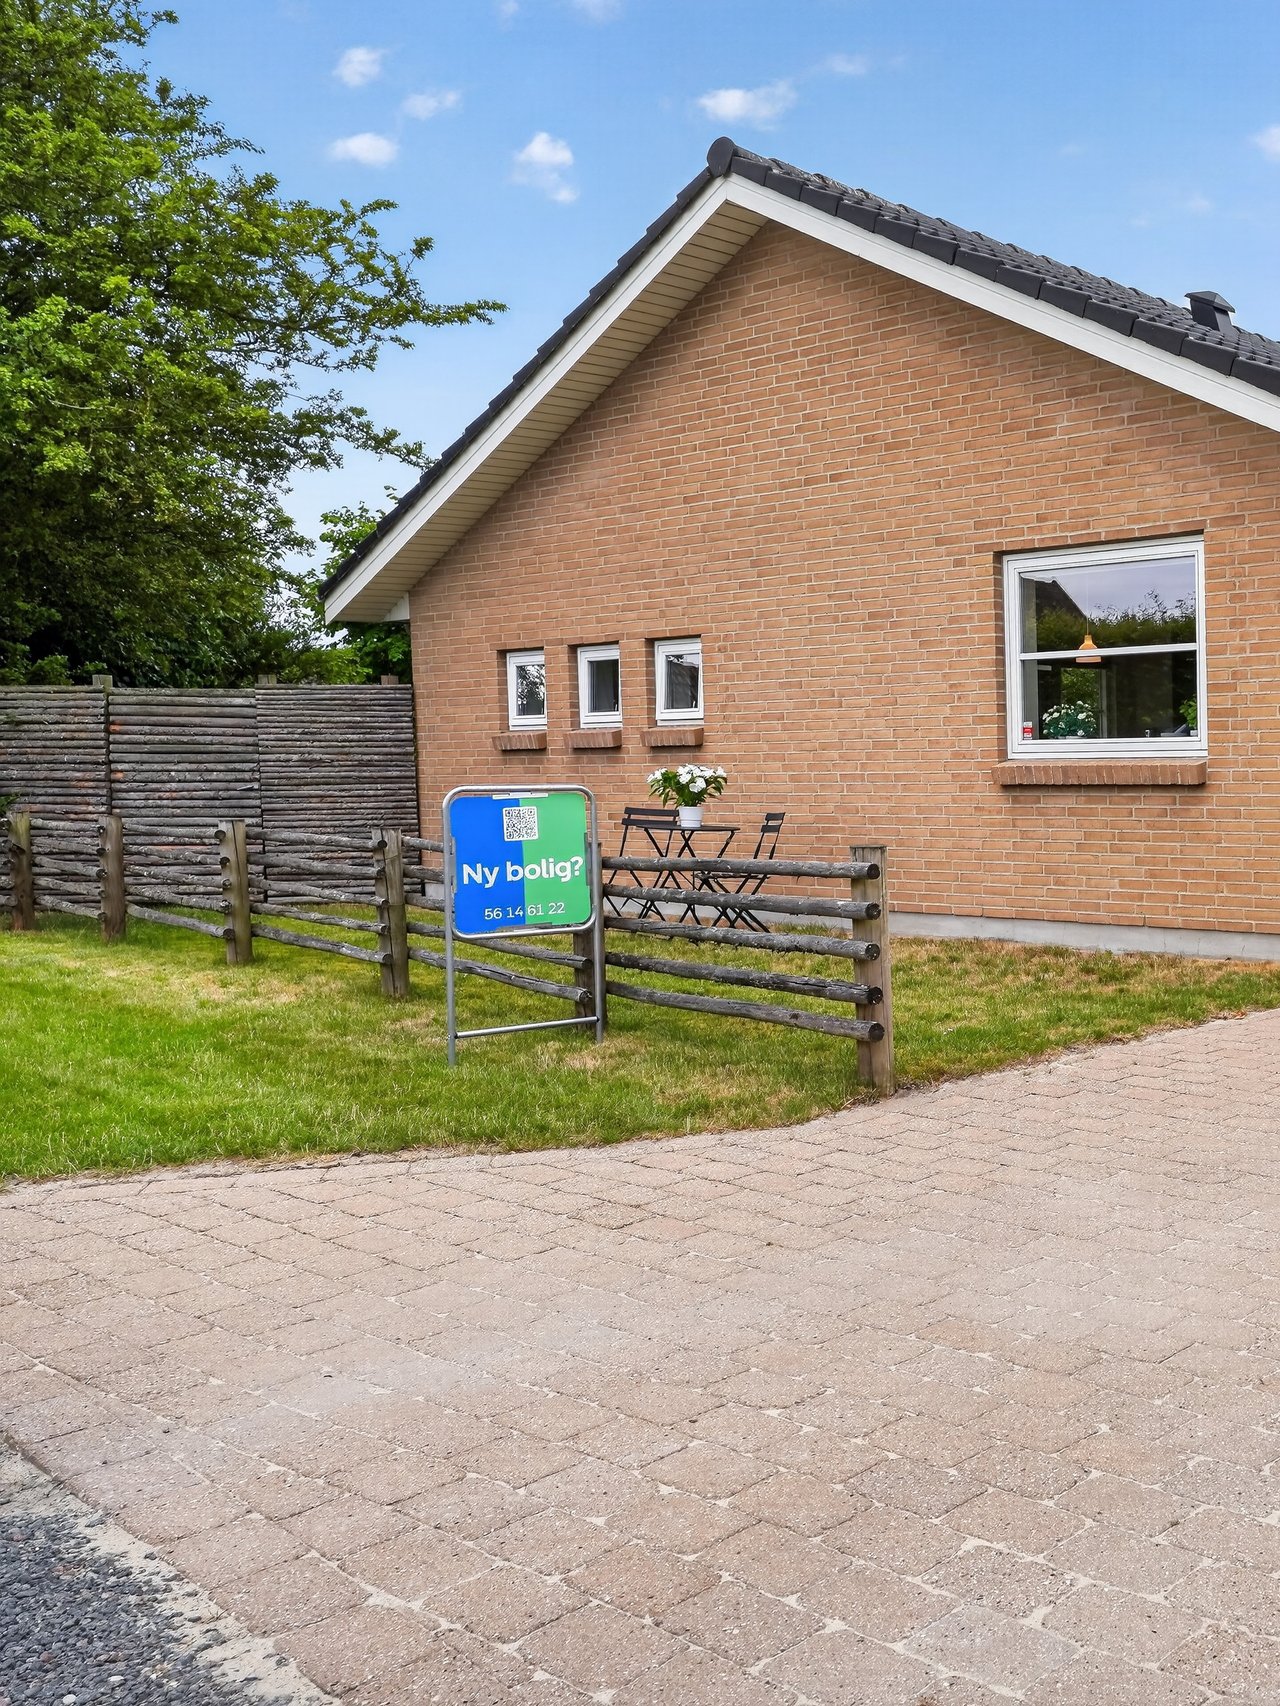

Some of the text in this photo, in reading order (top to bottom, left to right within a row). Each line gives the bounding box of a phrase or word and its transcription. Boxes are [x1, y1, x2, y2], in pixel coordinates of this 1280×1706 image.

[462, 856, 584, 889] Ny bolig?
[484, 902, 566, 920] 56 14 61 22
